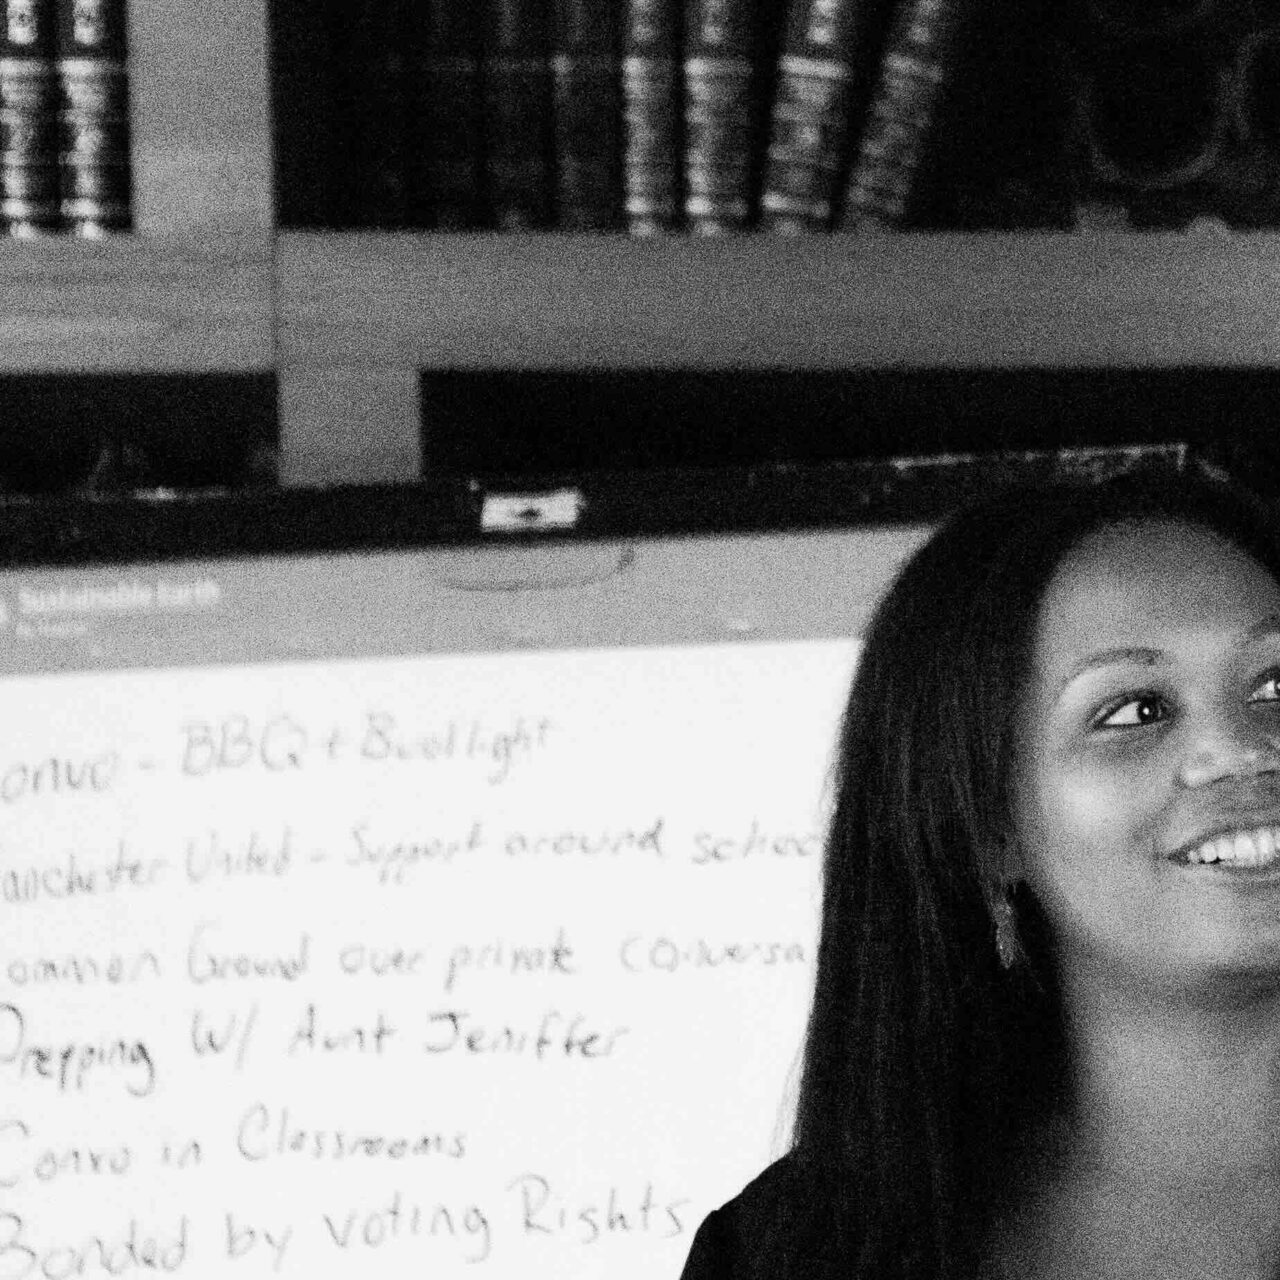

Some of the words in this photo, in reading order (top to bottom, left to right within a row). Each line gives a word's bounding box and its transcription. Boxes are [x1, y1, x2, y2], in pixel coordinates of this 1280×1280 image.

[180, 708, 308, 780] BBQ
[160, 1136, 204, 1172] in
[222, 1210, 294, 1274] by
[504, 1170, 694, 1246] Rights
